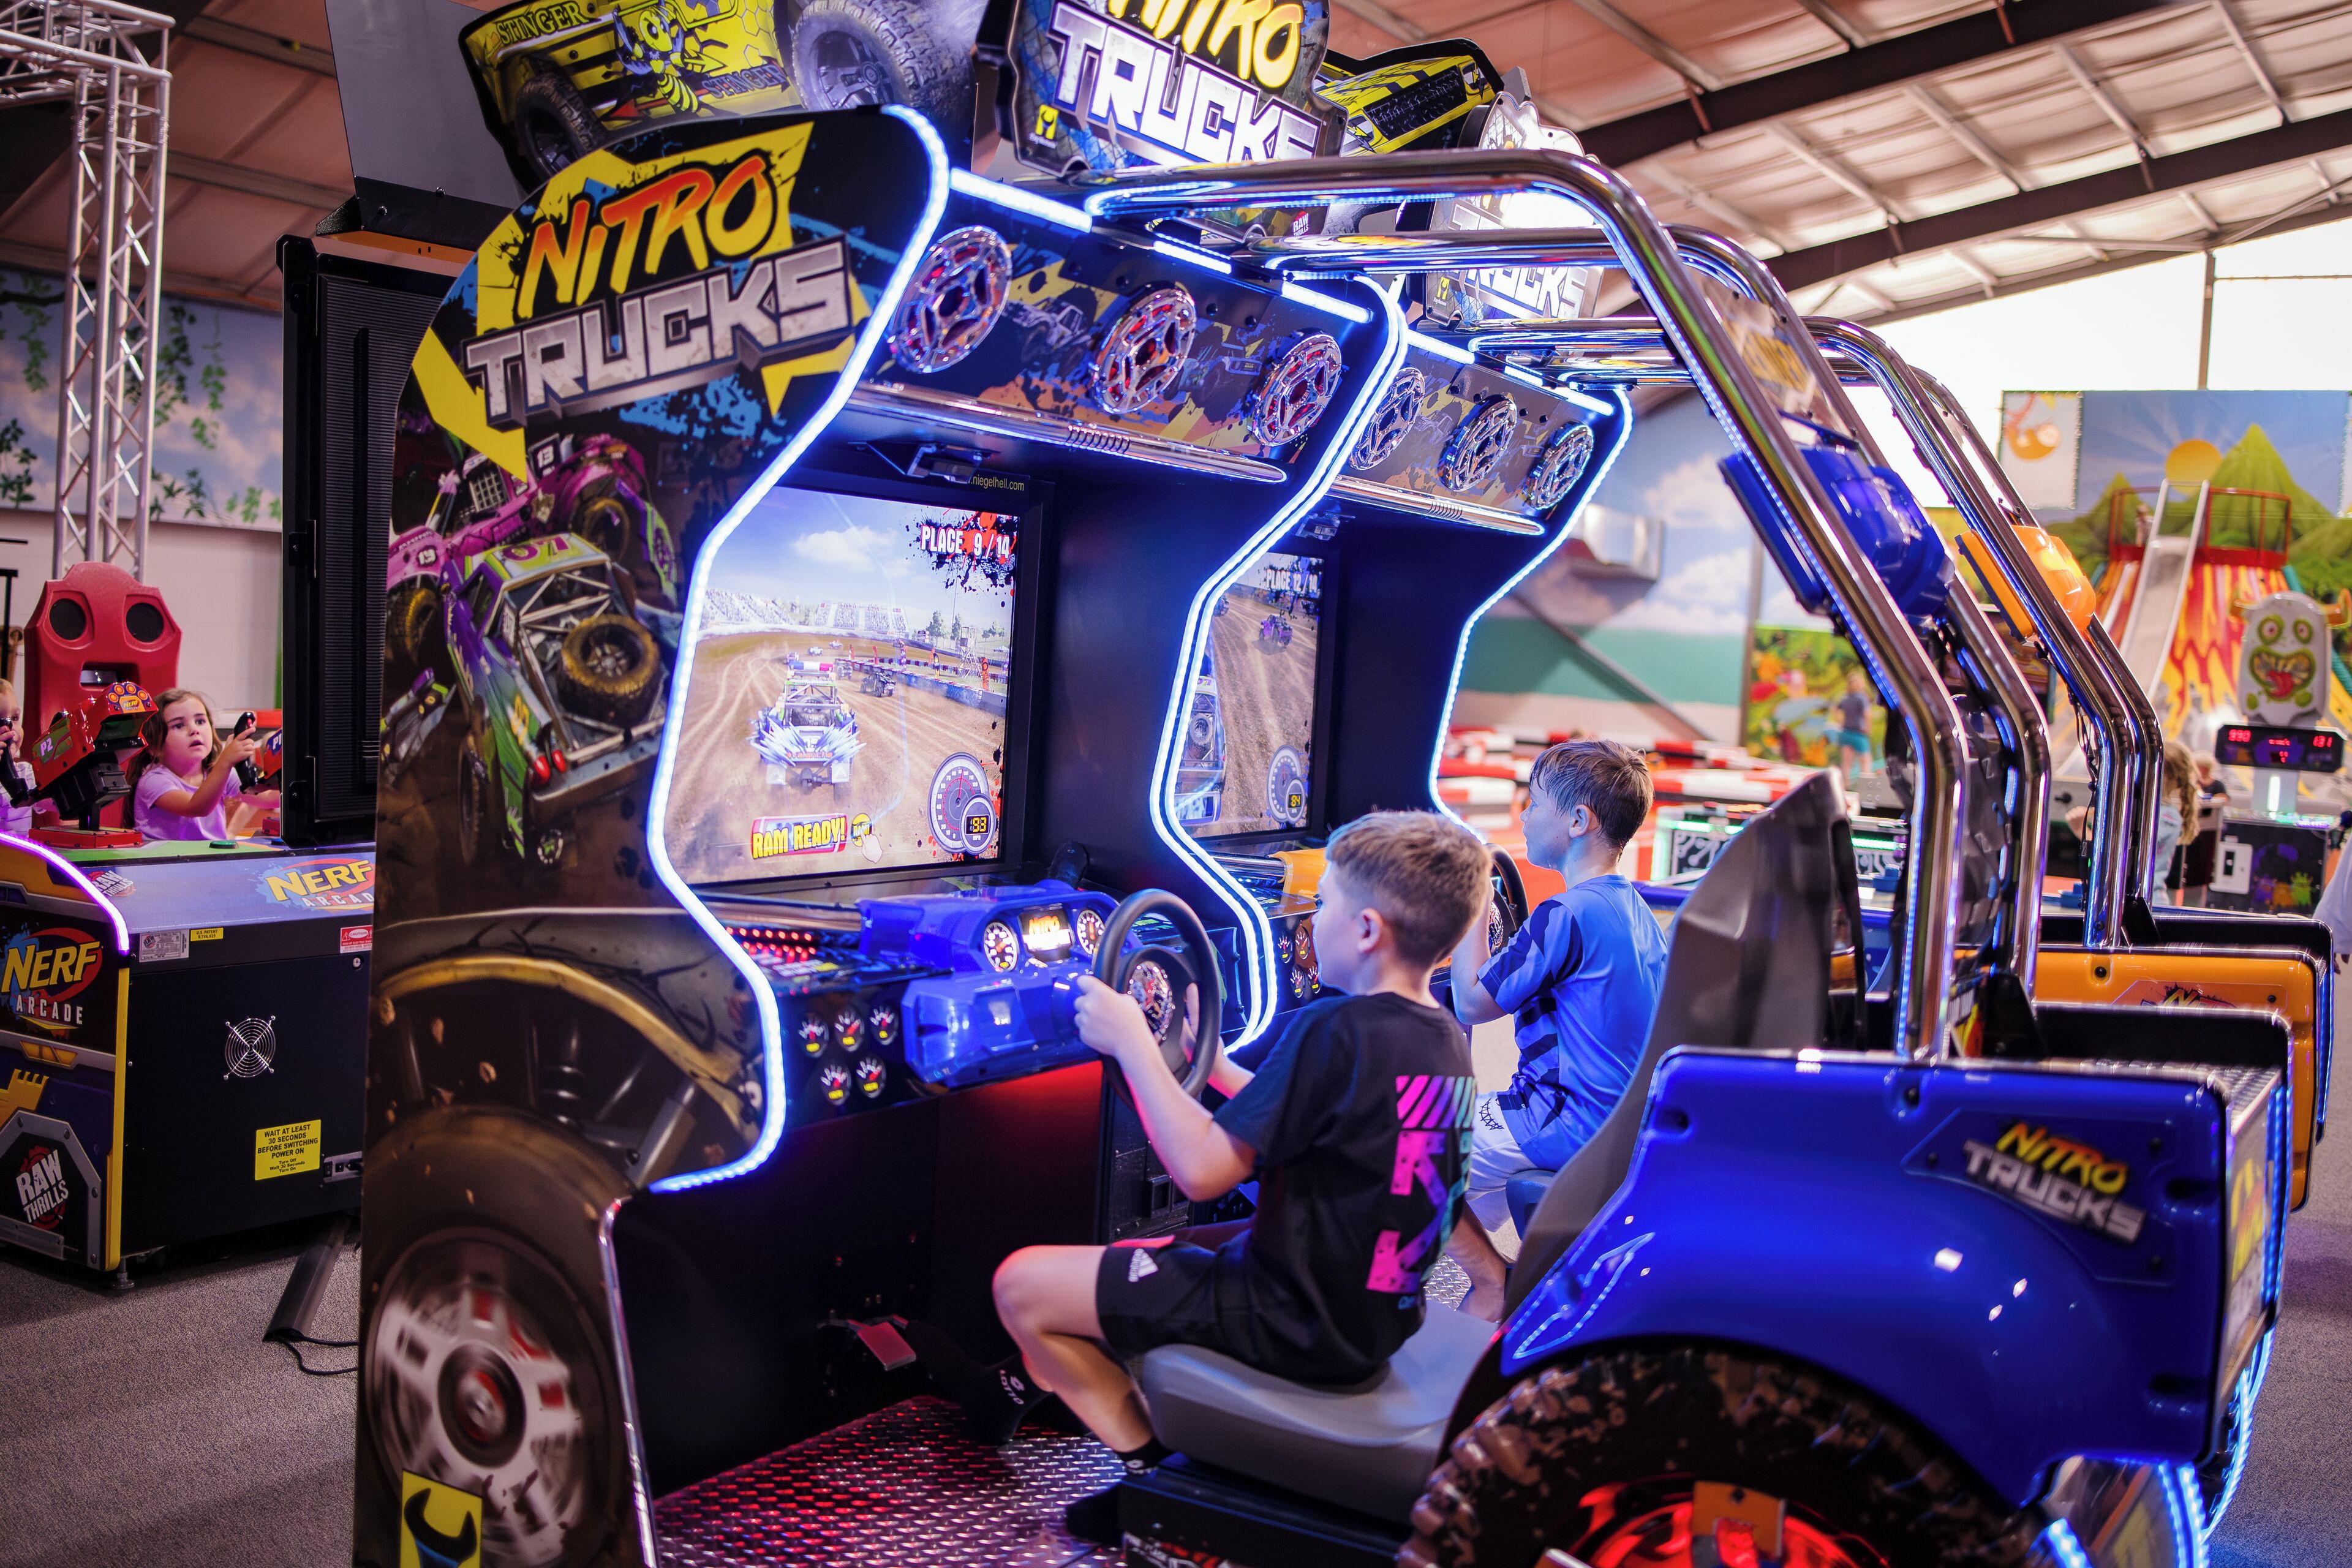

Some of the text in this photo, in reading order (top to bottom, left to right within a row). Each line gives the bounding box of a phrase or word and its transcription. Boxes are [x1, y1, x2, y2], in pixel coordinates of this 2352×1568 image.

[497, 1, 589, 44] STINGER
[1108, 0, 1303, 88] ITRO
[703, 63, 786, 99] STINGER
[1051, 3, 1320, 160] TRUCKS
[1293, 213, 1309, 233] RAW
[464, 240, 850, 419] TRUCKS
[968, 474, 1025, 491] .niegelhell.com
[921, 526, 963, 554] PLACE
[1266, 568, 1291, 590] PLACE
[40, 737, 53, 756] P2
[752, 816, 846, 859] RAM READY!
[102, 878, 134, 897] THRILLS
[265, 860, 372, 902] NERF
[1, 941, 100, 993] NERF
[16, 994, 83, 1025] ARCADE
[257, 1137, 318, 1153] BEFORE SWITCHING
[277, 1133, 306, 1142] SECONDS
[292, 1124, 311, 1133] LEAST
[272, 1150, 293, 1159] POWER
[16, 1150, 62, 1206] RAW
[1962, 1139, 2146, 1245] TRUCKS
[23, 1180, 69, 1223] THRILLS
